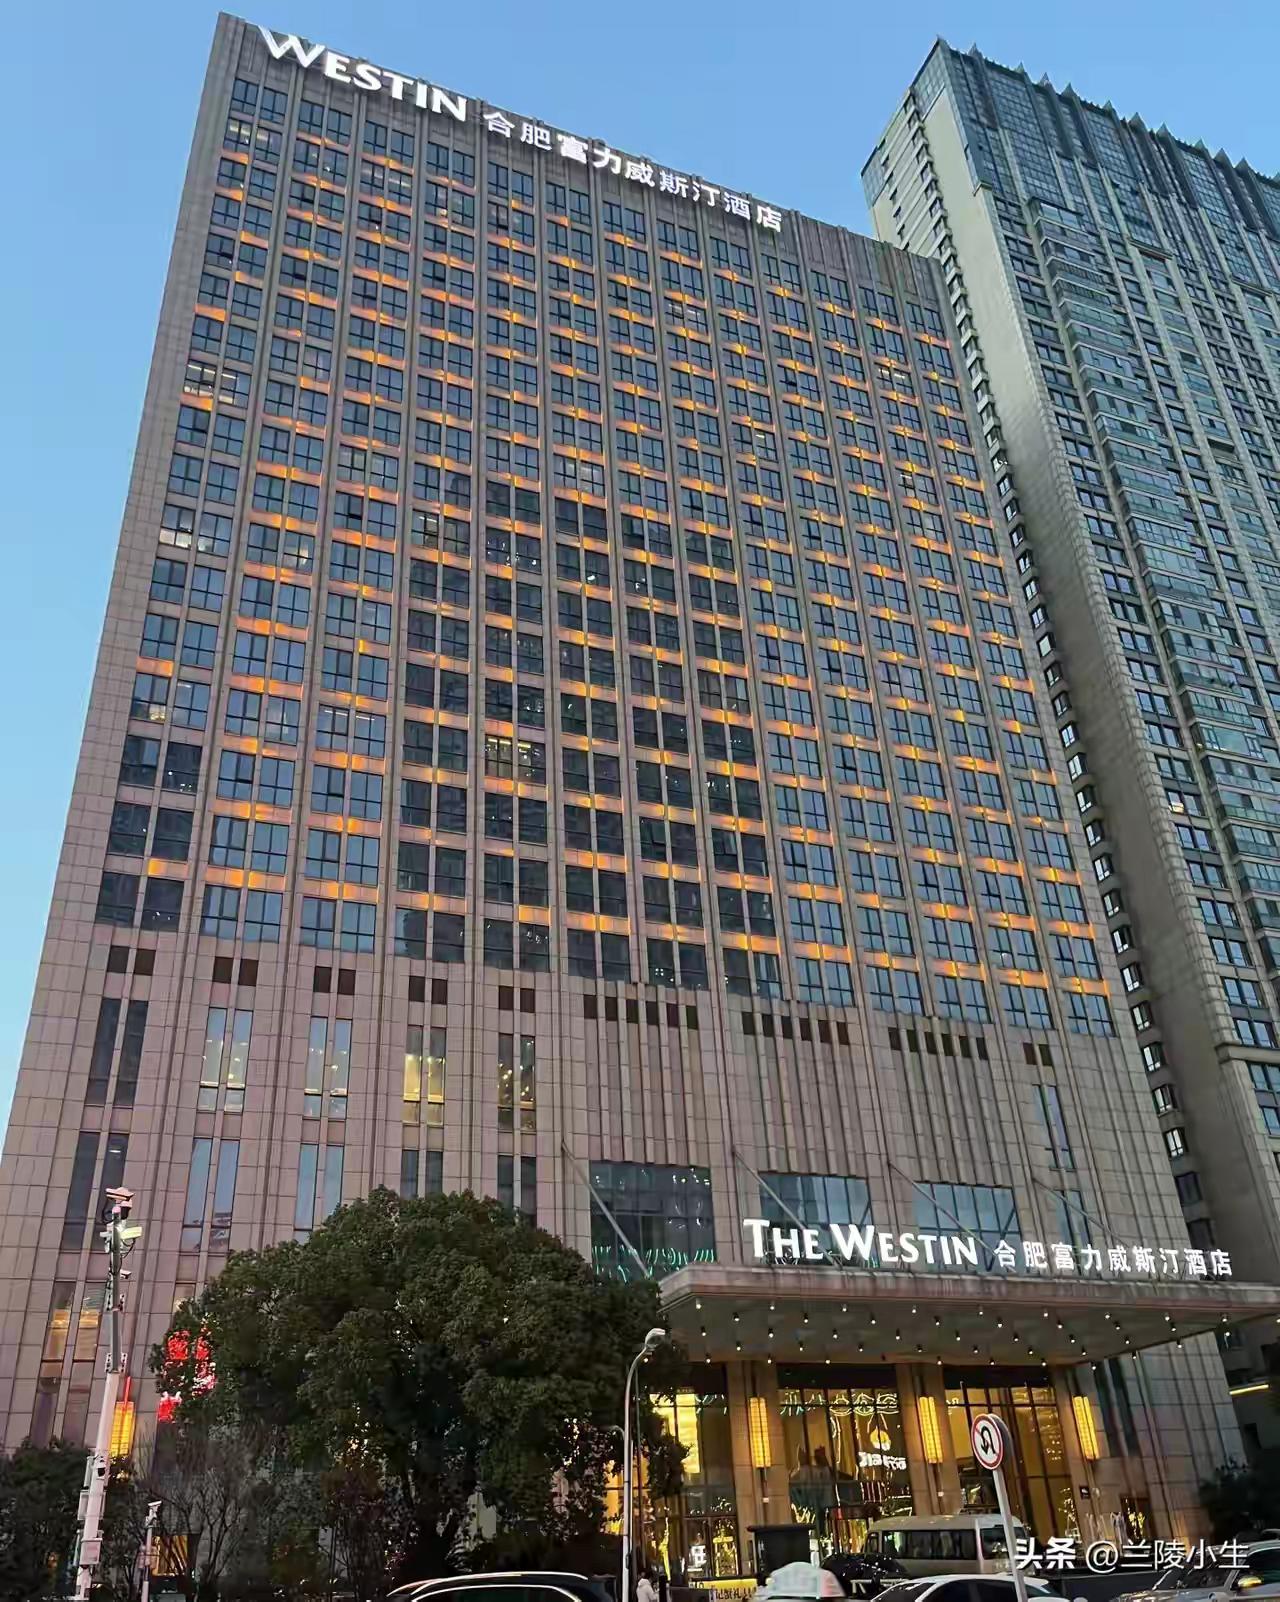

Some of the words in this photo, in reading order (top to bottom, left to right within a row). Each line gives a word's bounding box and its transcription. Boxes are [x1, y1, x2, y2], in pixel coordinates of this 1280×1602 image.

[258, 27, 467, 122] WESTIN
[483, 111, 782, 232] 合肥富力威斯汀酒店
[743, 1219, 823, 1260] THE
[829, 1224, 979, 1266] WESTIN
[993, 1240, 1233, 1276] 合肥富力威斯汀酒店
